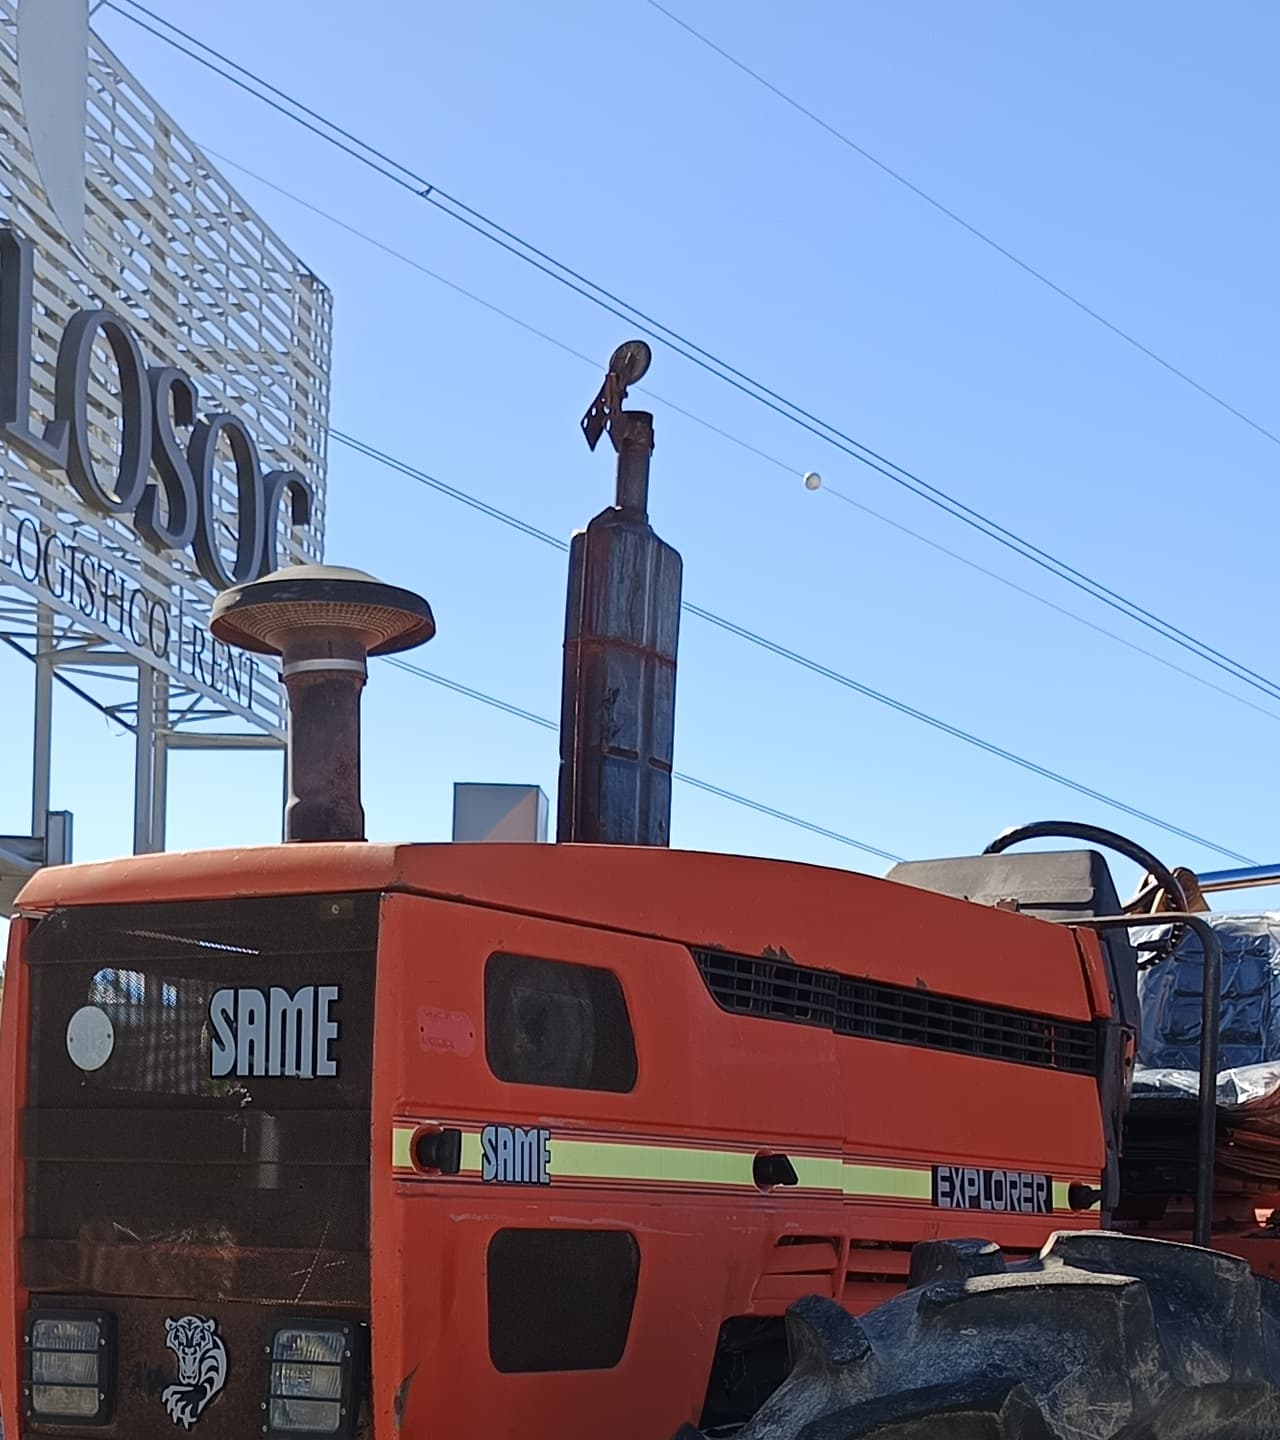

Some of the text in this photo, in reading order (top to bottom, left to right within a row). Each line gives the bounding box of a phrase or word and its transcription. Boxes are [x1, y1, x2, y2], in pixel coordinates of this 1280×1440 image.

[191, 622, 260, 711] RENT
[208, 983, 342, 1081] SAME
[481, 1124, 552, 1186] SAME
[937, 1165, 1048, 1214] EXPLORER
